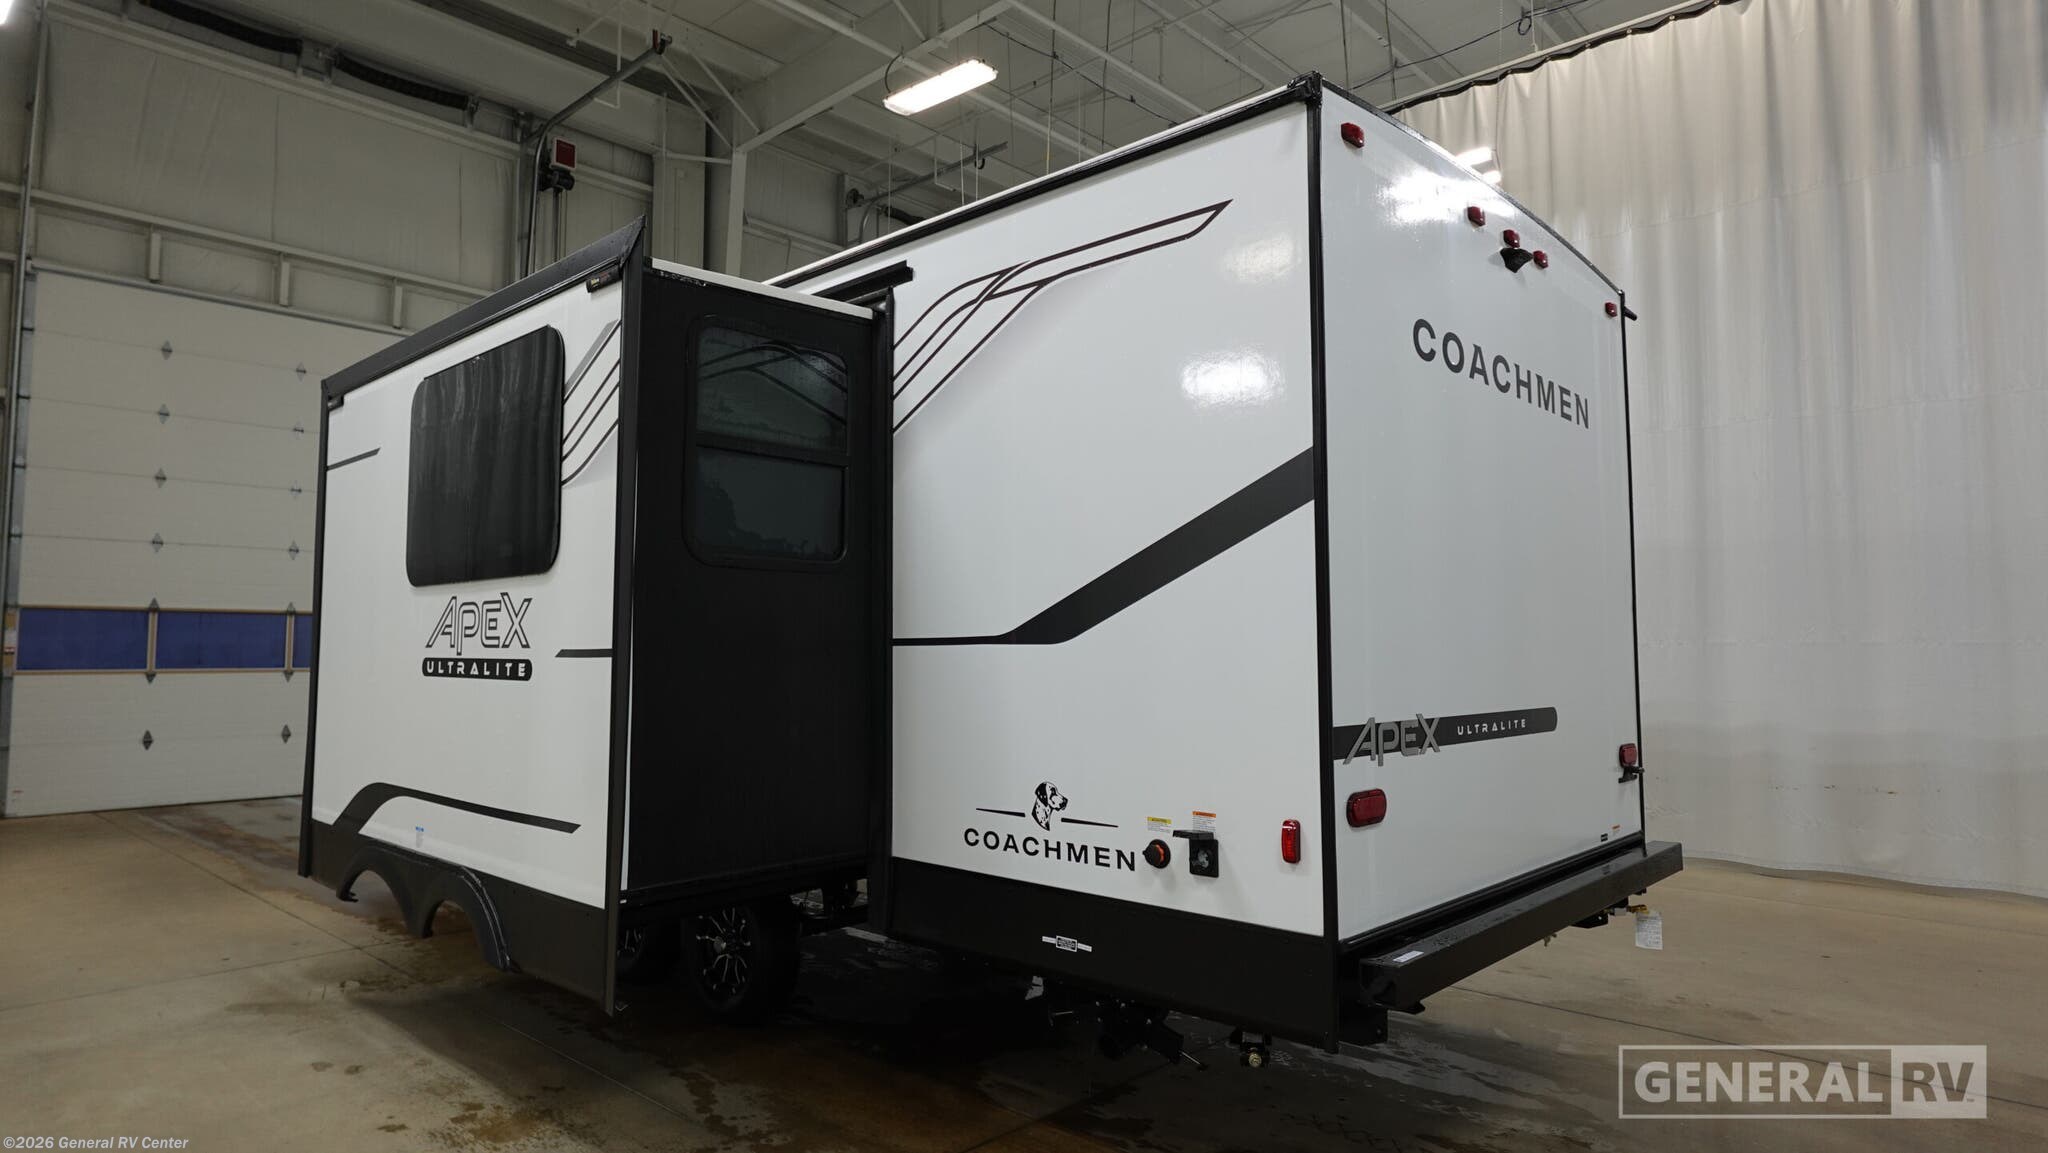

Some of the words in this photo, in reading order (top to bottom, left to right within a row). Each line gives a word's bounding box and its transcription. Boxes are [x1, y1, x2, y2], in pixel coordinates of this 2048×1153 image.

[1412, 318, 1590, 429] COACHMEN
[426, 660, 527, 677] ULTRALITE
[1457, 719, 1527, 736] ULTRALITE
[963, 827, 1136, 872] COACHMEN
